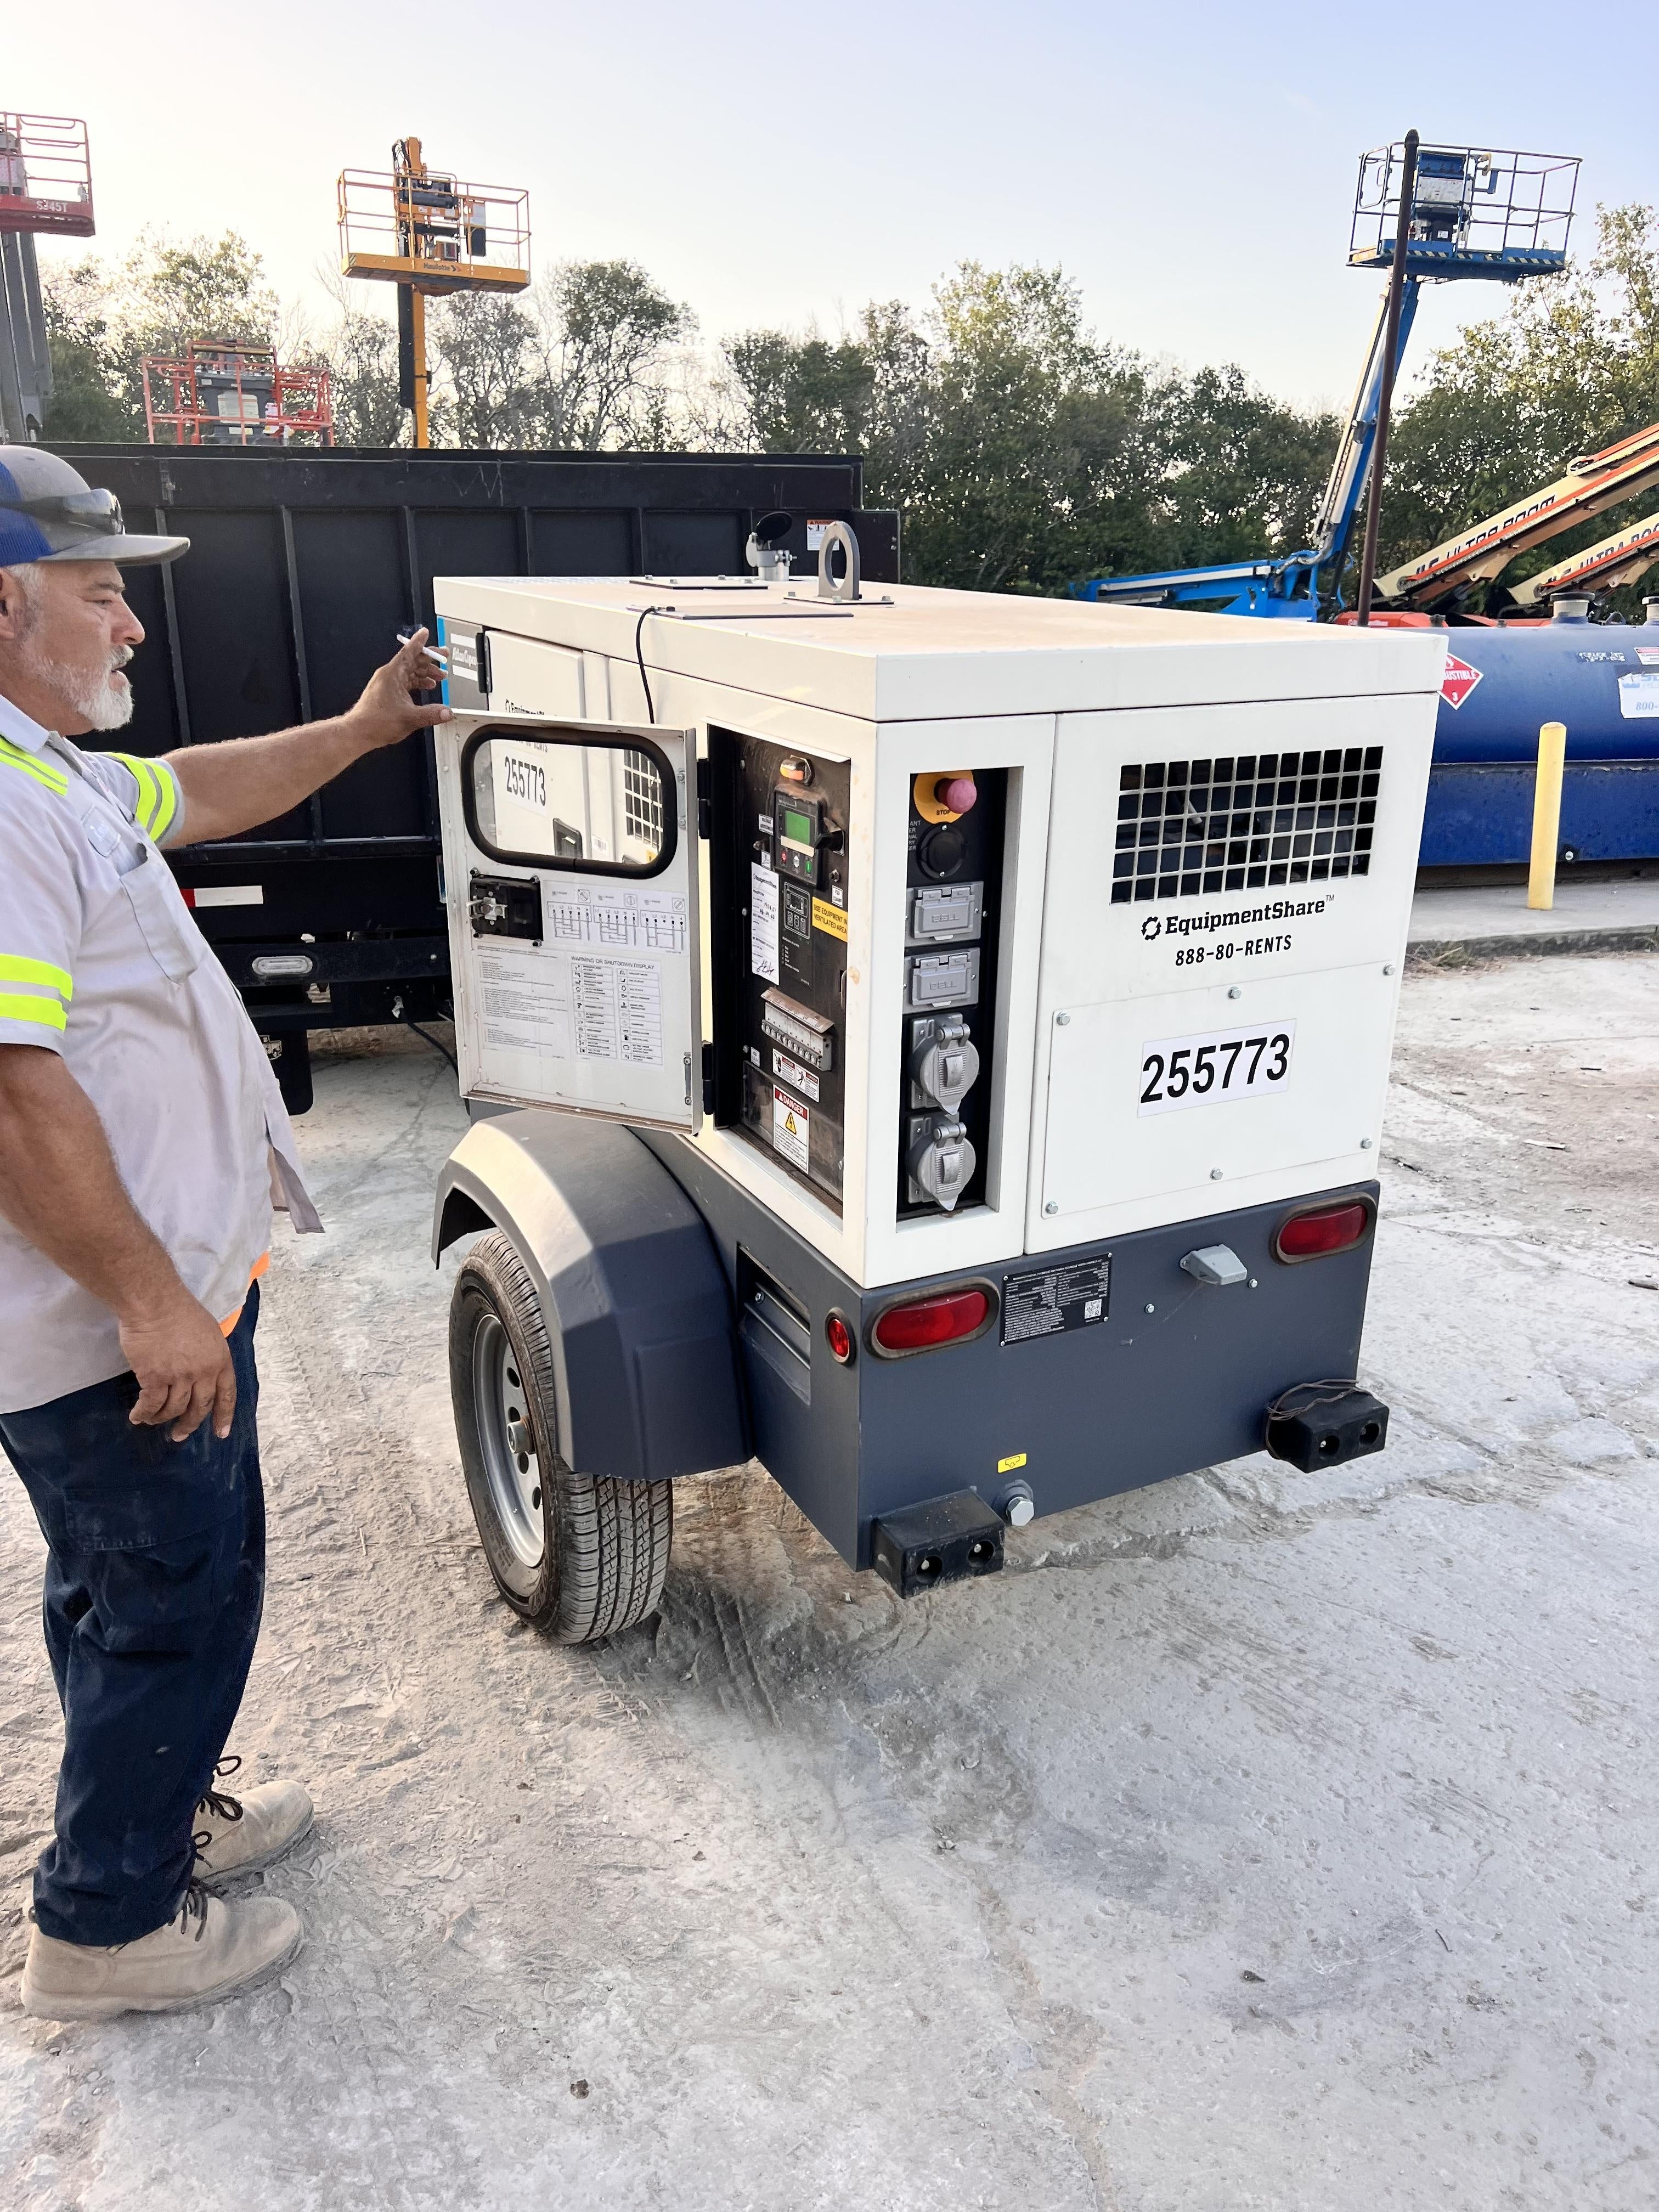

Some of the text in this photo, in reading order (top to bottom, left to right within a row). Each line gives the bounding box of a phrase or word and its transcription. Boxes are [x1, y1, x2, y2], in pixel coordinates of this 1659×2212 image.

[1445, 670, 1476, 681] USTIBLE
[1451, 691, 1459, 702] 3
[505, 756, 546, 806] 255773
[814, 913, 836, 929] VENTILATED
[821, 907, 843, 922] EQUIPMENT
[932, 912, 960, 923] BELL
[1165, 899, 1325, 936] EquipmentShare
[1175, 934, 1292, 966] 888-80-RENTS
[604, 960, 633, 968] SHUTDOWN
[929, 980, 957, 991] BELL
[1140, 1033, 1290, 1104] 255773
[783, 1094, 804, 1116] DANGER
